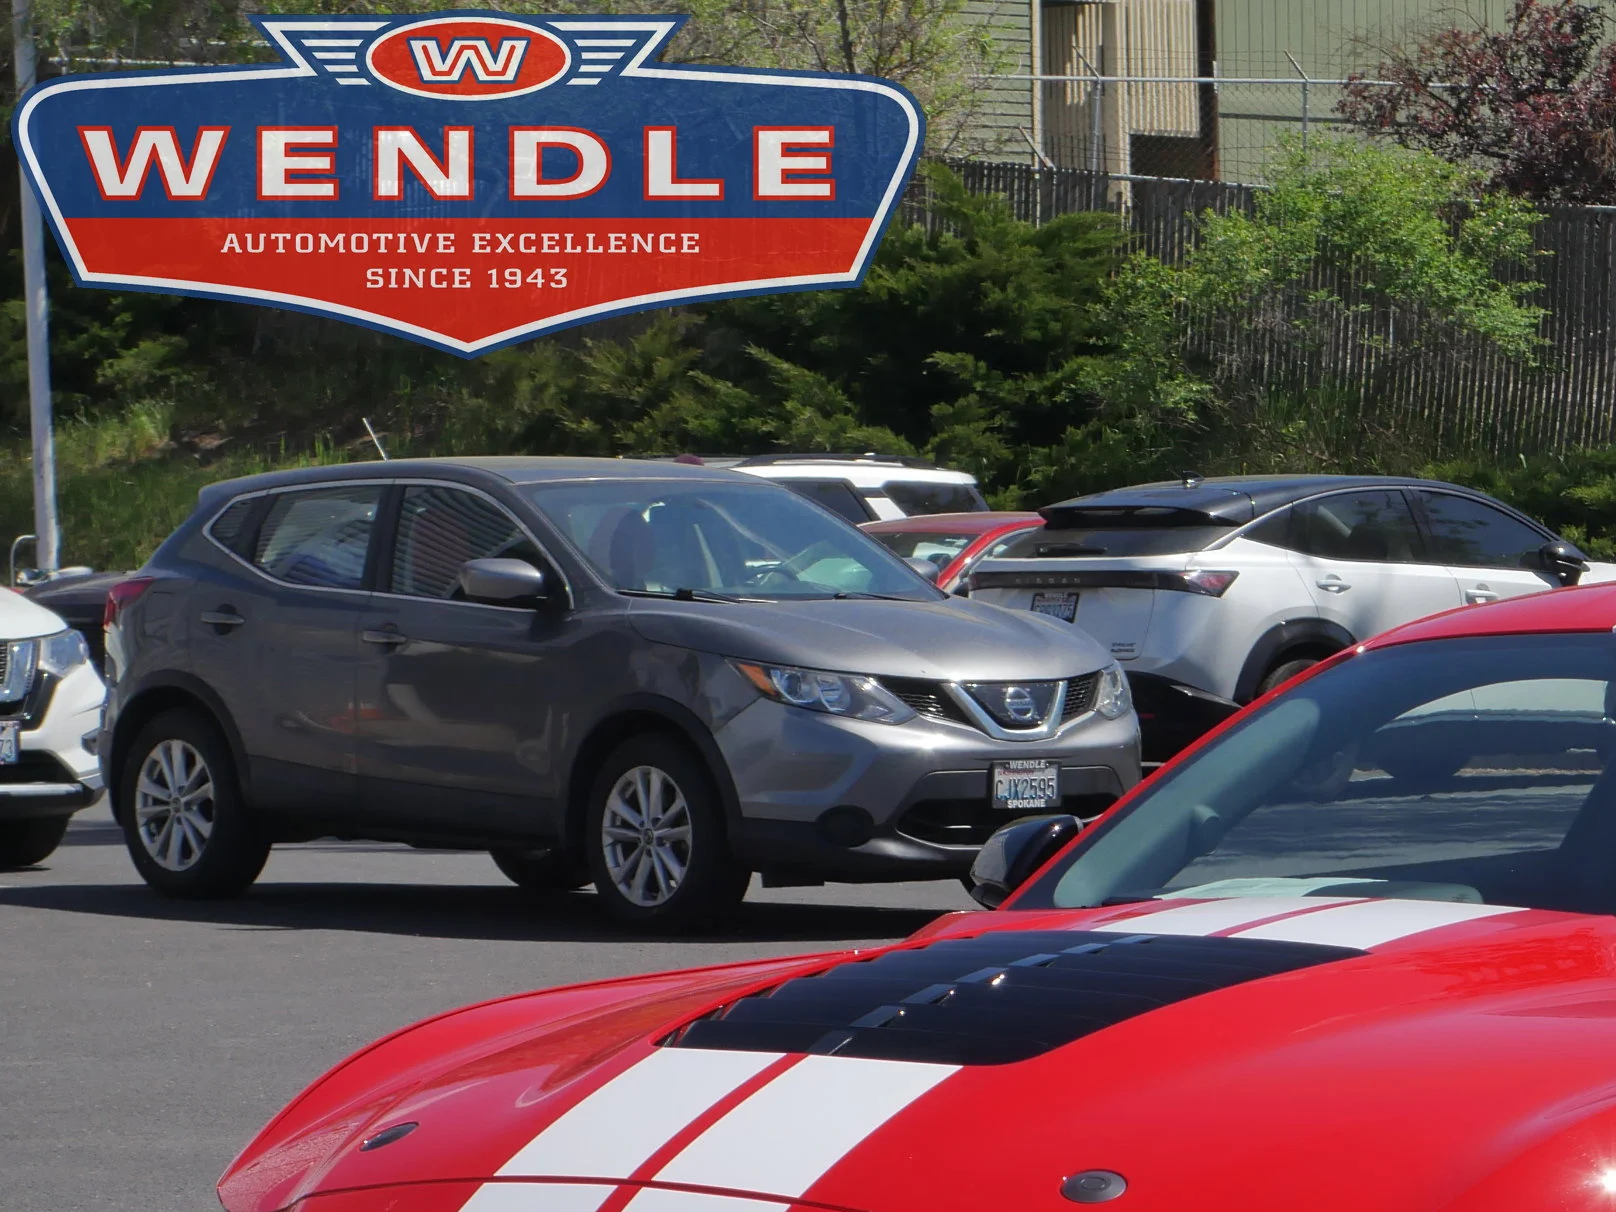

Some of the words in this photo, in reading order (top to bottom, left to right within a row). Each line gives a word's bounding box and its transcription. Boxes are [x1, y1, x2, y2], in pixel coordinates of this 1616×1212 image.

[1010, 760, 1046, 769] WENDLE
[995, 777, 1056, 800] CJX2595
[1007, 799, 1046, 809] SPOKANE
